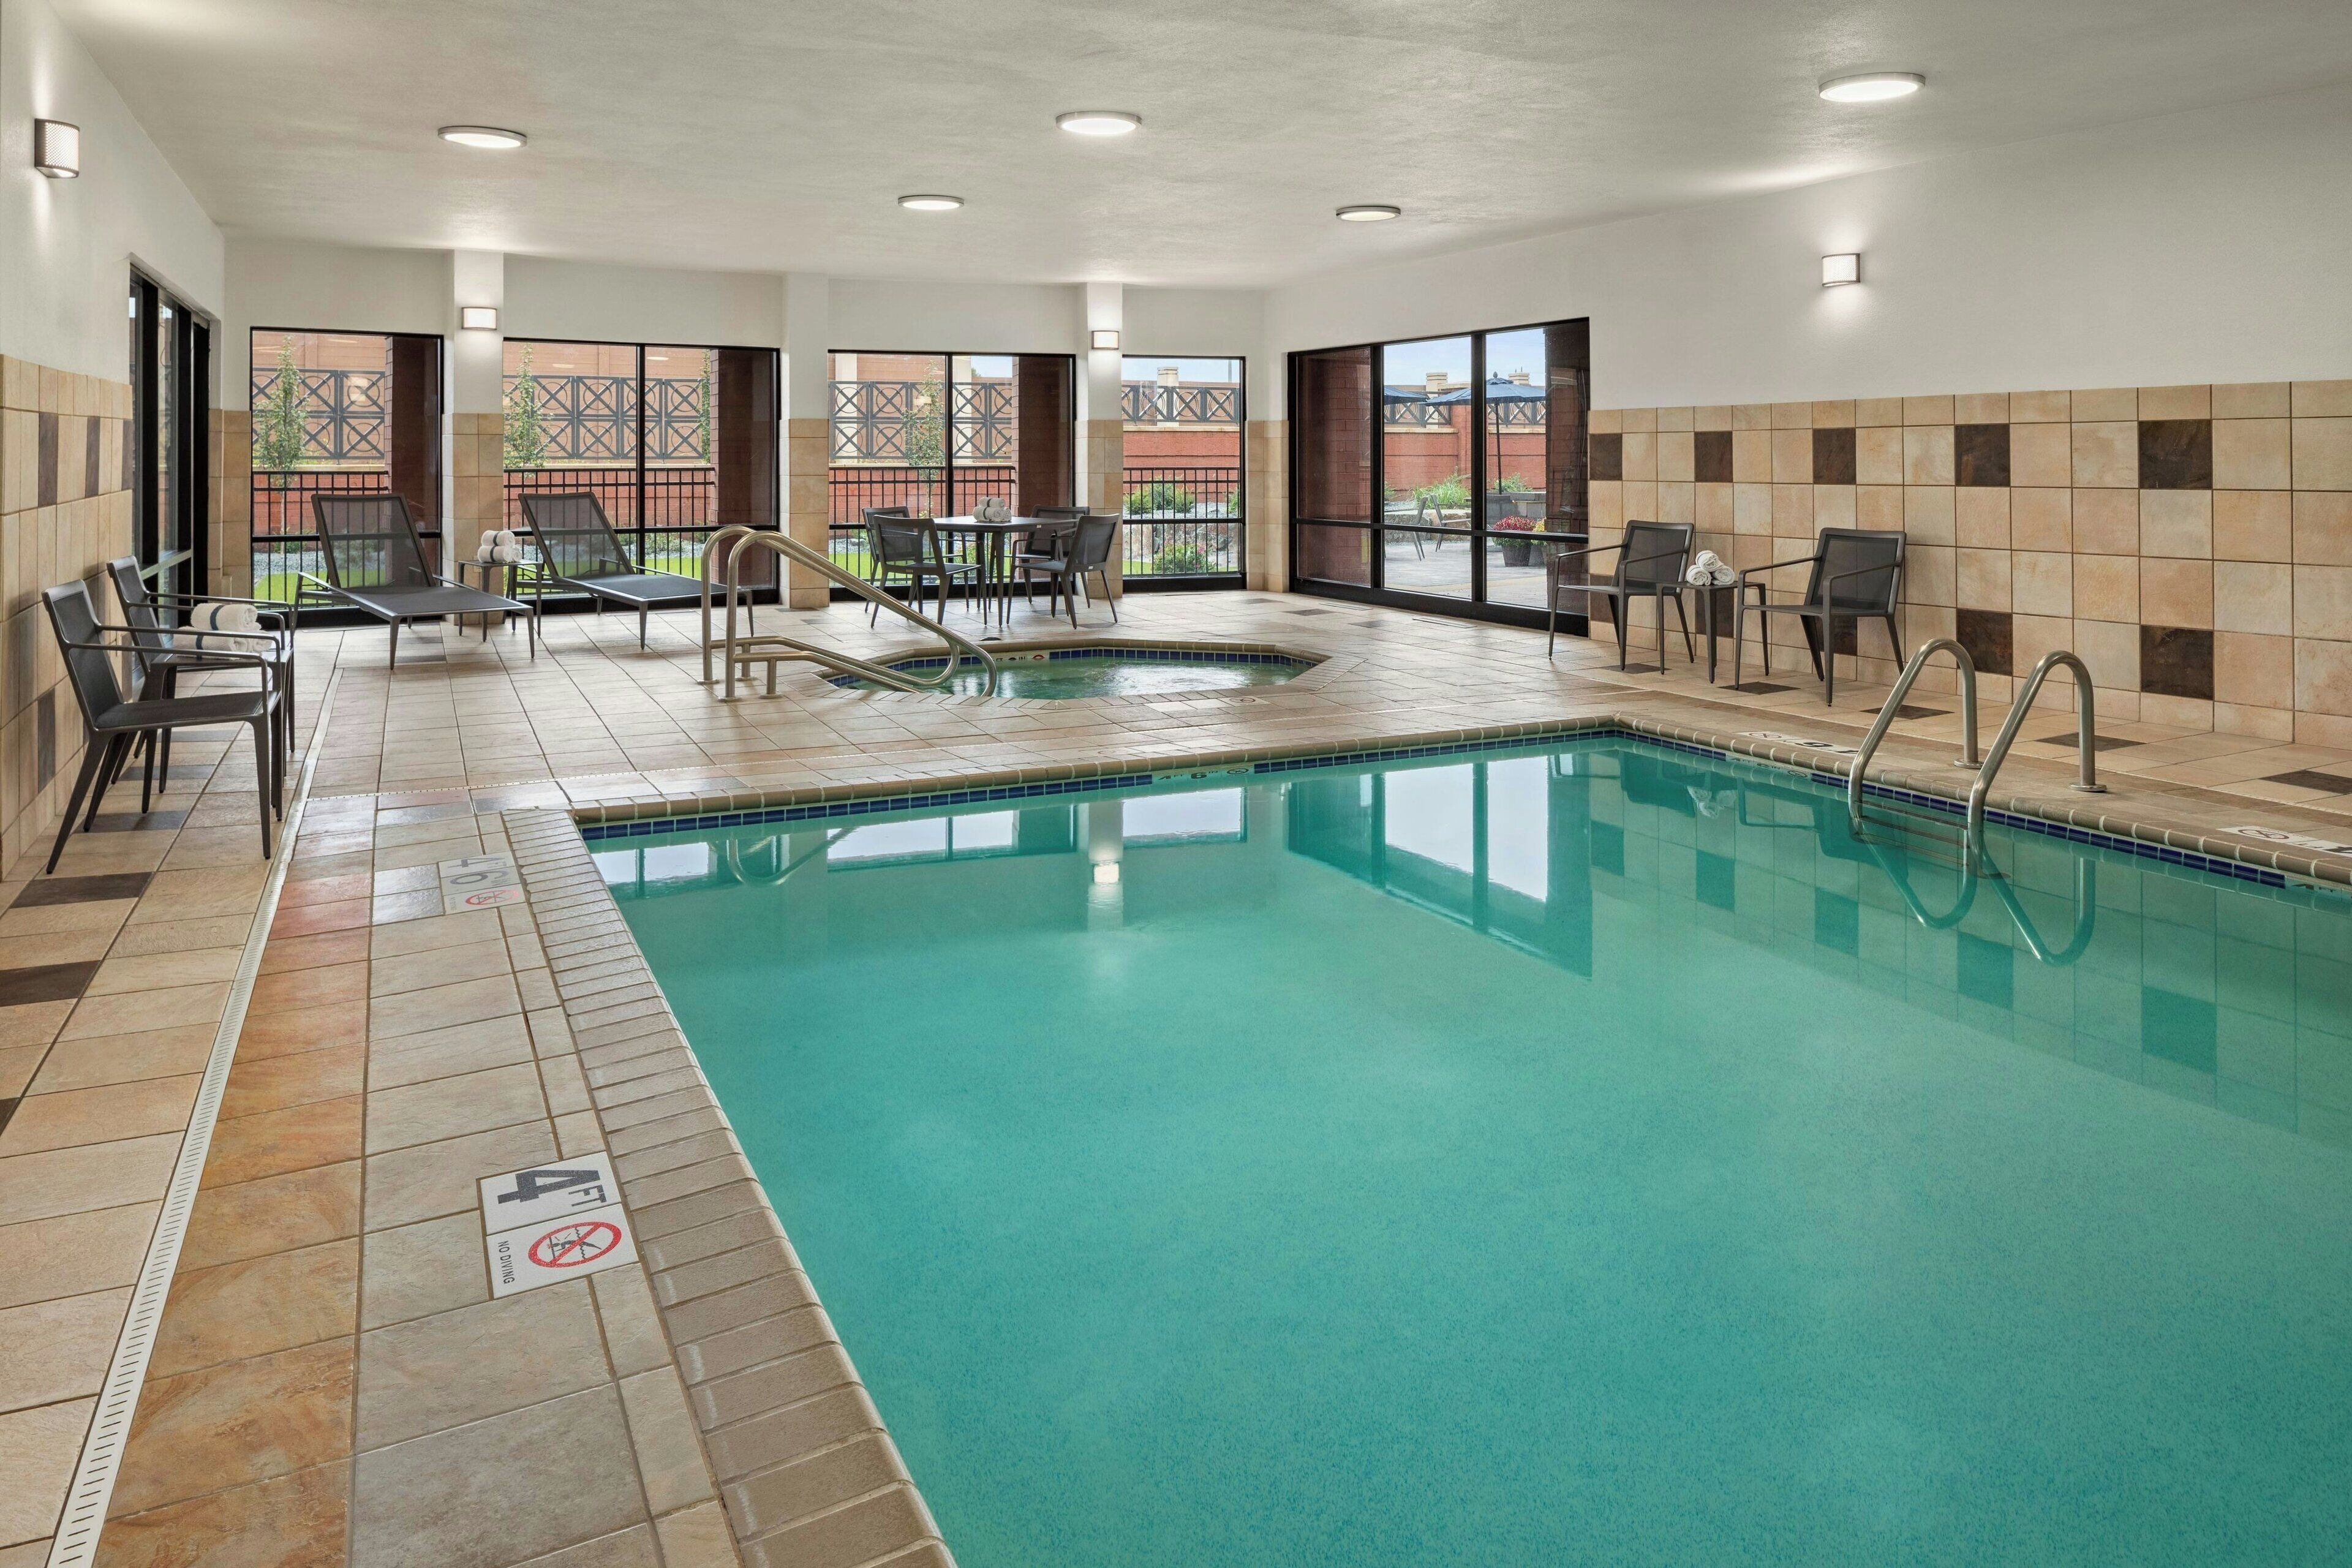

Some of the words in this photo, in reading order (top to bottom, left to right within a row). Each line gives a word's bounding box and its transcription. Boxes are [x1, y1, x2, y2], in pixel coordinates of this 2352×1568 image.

[448, 858, 505, 868] 4
[497, 1170, 600, 1204] 4
[568, 1185, 607, 1207] FT
[498, 1240, 510, 1253] NO
[500, 1254, 515, 1284] DIVING
